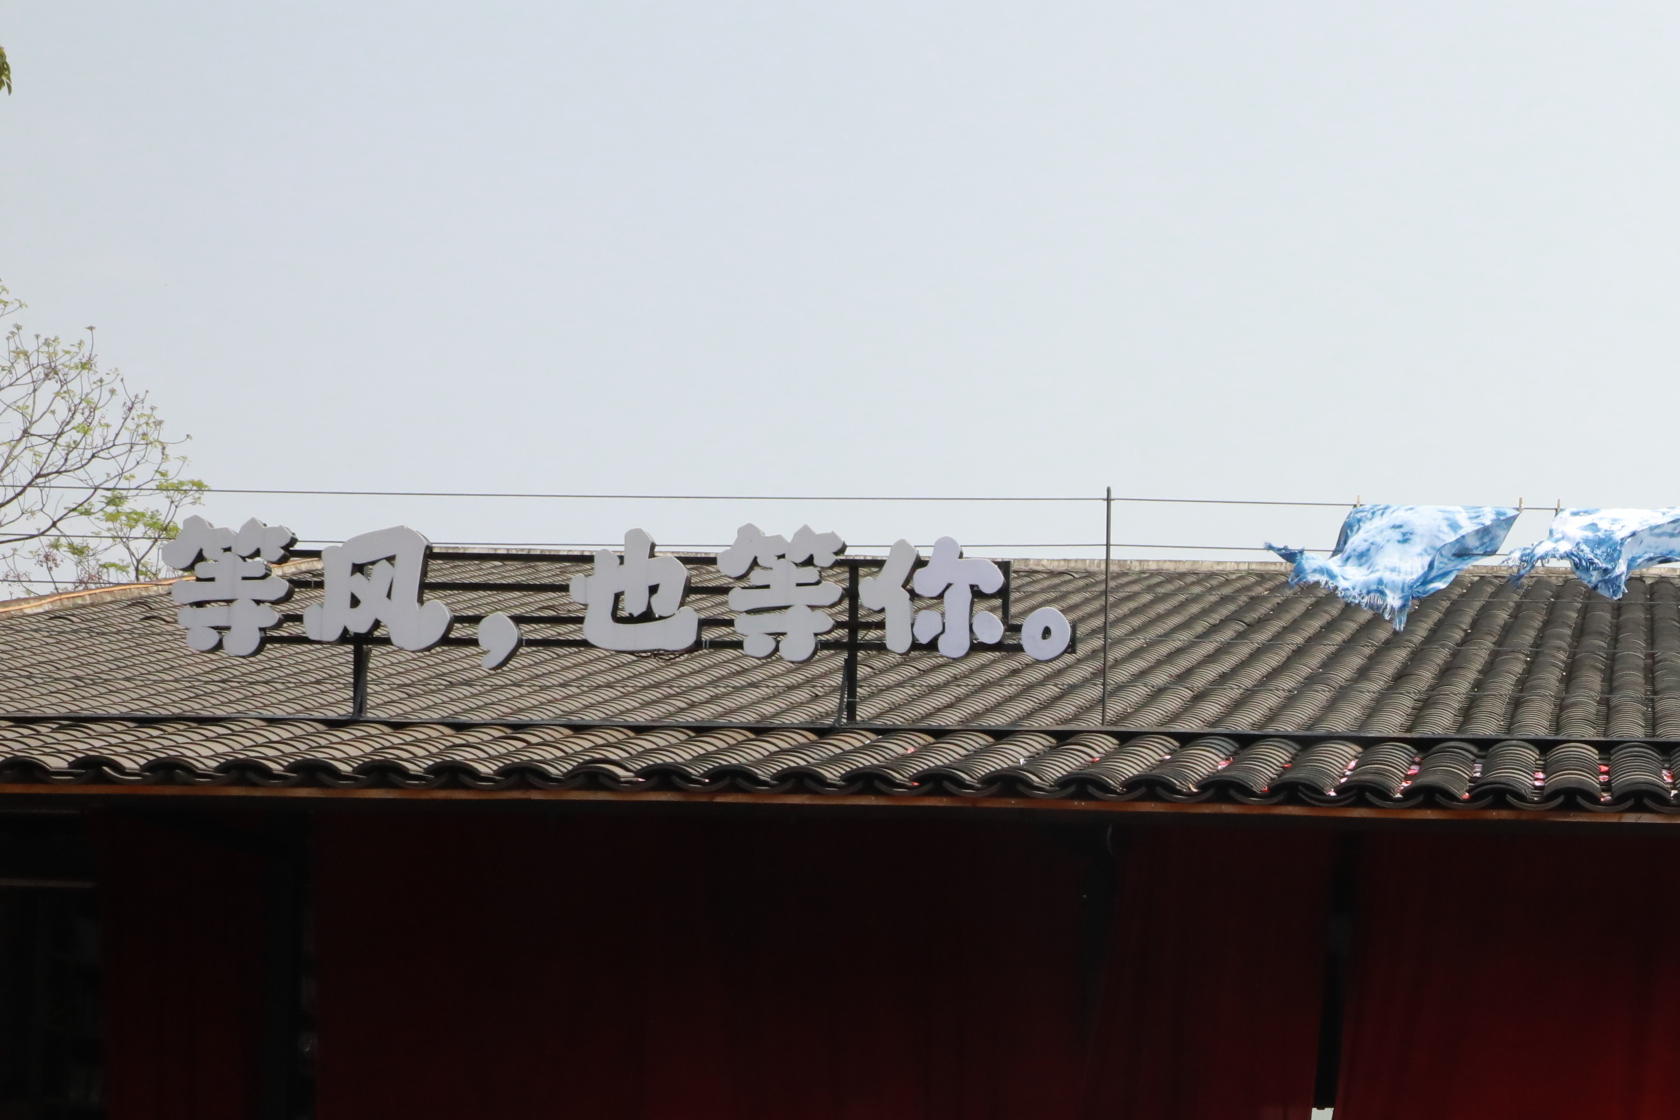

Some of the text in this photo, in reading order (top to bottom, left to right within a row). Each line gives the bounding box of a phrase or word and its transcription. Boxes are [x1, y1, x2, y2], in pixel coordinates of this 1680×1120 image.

[162, 514, 1072, 671] 等风，也等你。
